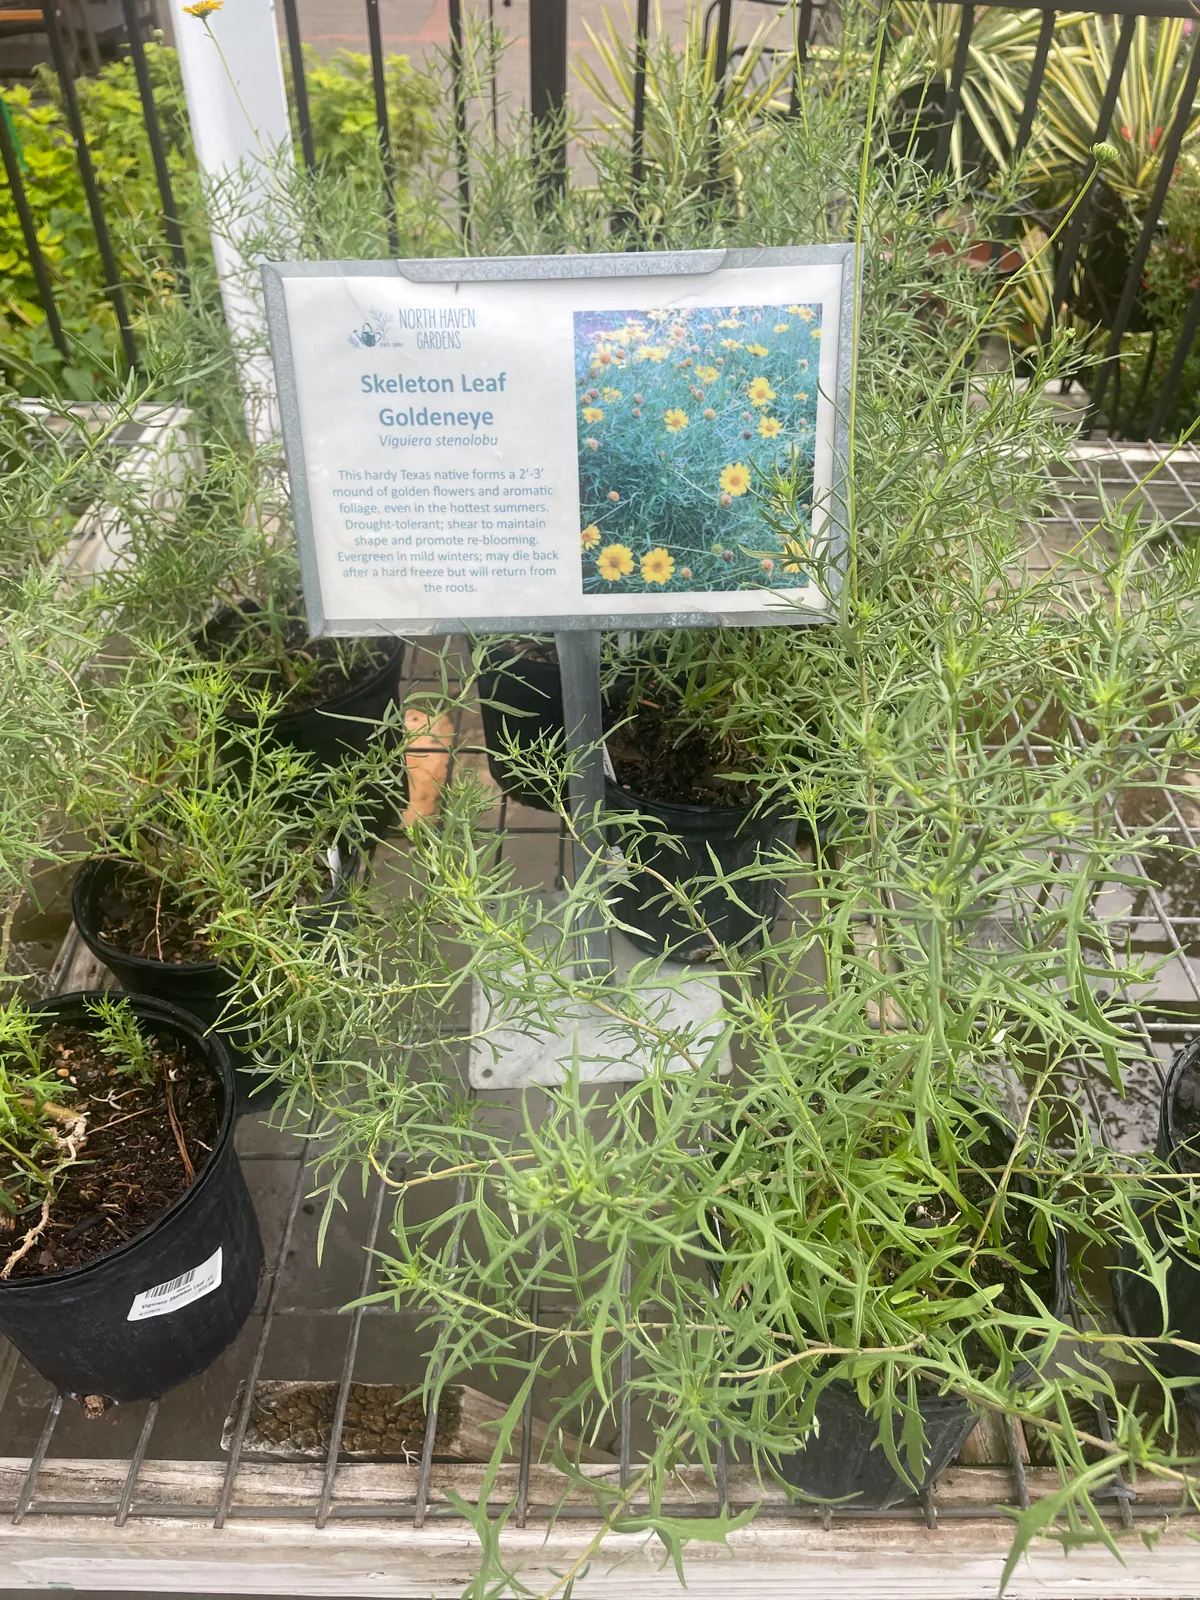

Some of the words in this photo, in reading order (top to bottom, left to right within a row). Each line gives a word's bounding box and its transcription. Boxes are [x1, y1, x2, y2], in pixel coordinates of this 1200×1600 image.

[398, 308, 436, 329] NORTH
[440, 308, 476, 328] HAVEN
[416, 330, 461, 350] GARDENS
[361, 374, 454, 393] Skeleton
[462, 372, 506, 392] Leaf
[379, 407, 494, 429] Goldeneye
[379, 435, 432, 449] Viguiera
[338, 470, 361, 480] This
[365, 470, 397, 482] hardy
[400, 470, 431, 480] Texas
[434, 469, 469, 480] native
[473, 468, 505, 480] forms
[333, 486, 373, 497] mound
[376, 486, 388, 497] of
[391, 485, 429, 499] golden
[433, 485, 475, 496] flowers
[478, 485, 500, 496] and
[503, 485, 553, 496] aromatic
[339, 503, 381, 515] foliage,
[384, 505, 411, 513] even
[414, 503, 424, 513] in
[428, 503, 447, 513] the
[450, 502, 490, 513] hottest
[493, 504, 549, 512] summers.
[345, 519, 444, 532] Drought-tolerant;
[447, 519, 478, 529] shear
[481, 520, 493, 529] to
[496, 519, 546, 529] maintain
[355, 535, 388, 548] shape
[391, 535, 412, 546] and
[415, 536, 464, 547] promote
[467, 534, 539, 546] re-blooming.
[338, 552, 393, 563] Evergreen
[397, 552, 407, 562] in
[410, 551, 434, 562] mild
[438, 551, 483, 563] winters;
[486, 553, 509, 563] may
[512, 550, 530, 561] die
[533, 550, 558, 560] back
[342, 567, 368, 578] after
[382, 567, 407, 577] hard
[410, 566, 444, 577] freeze
[447, 567, 466, 577] but
[469, 566, 488, 576] will
[492, 568, 526, 576] return
[530, 566, 556, 576] from
[424, 583, 442, 593] the
[445, 583, 478, 593] roots.
